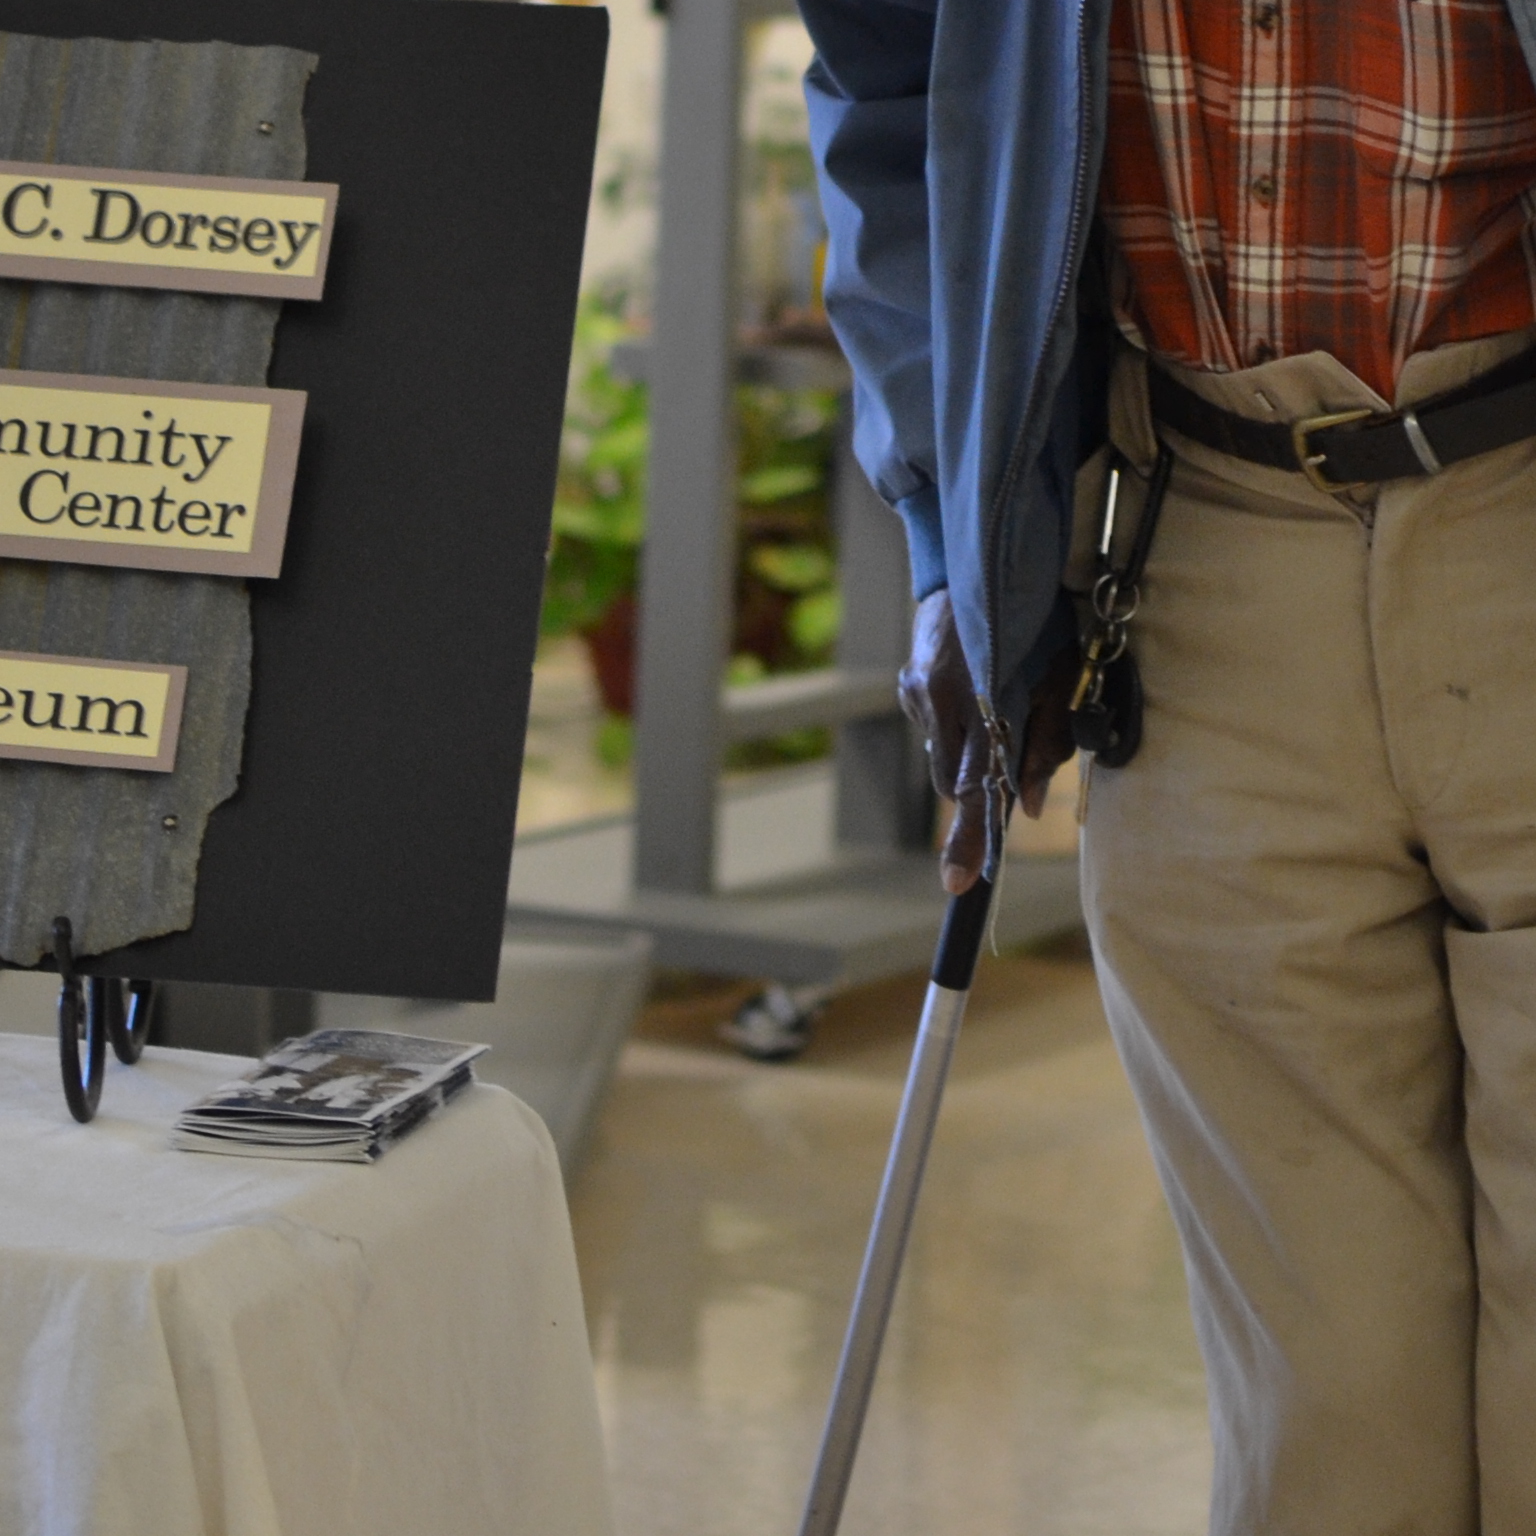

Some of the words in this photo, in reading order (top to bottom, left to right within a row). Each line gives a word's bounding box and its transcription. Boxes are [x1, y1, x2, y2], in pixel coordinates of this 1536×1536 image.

[1, 182, 64, 241] C.
[82, 188, 321, 269] Dorsey
[18, 469, 247, 540] Center
